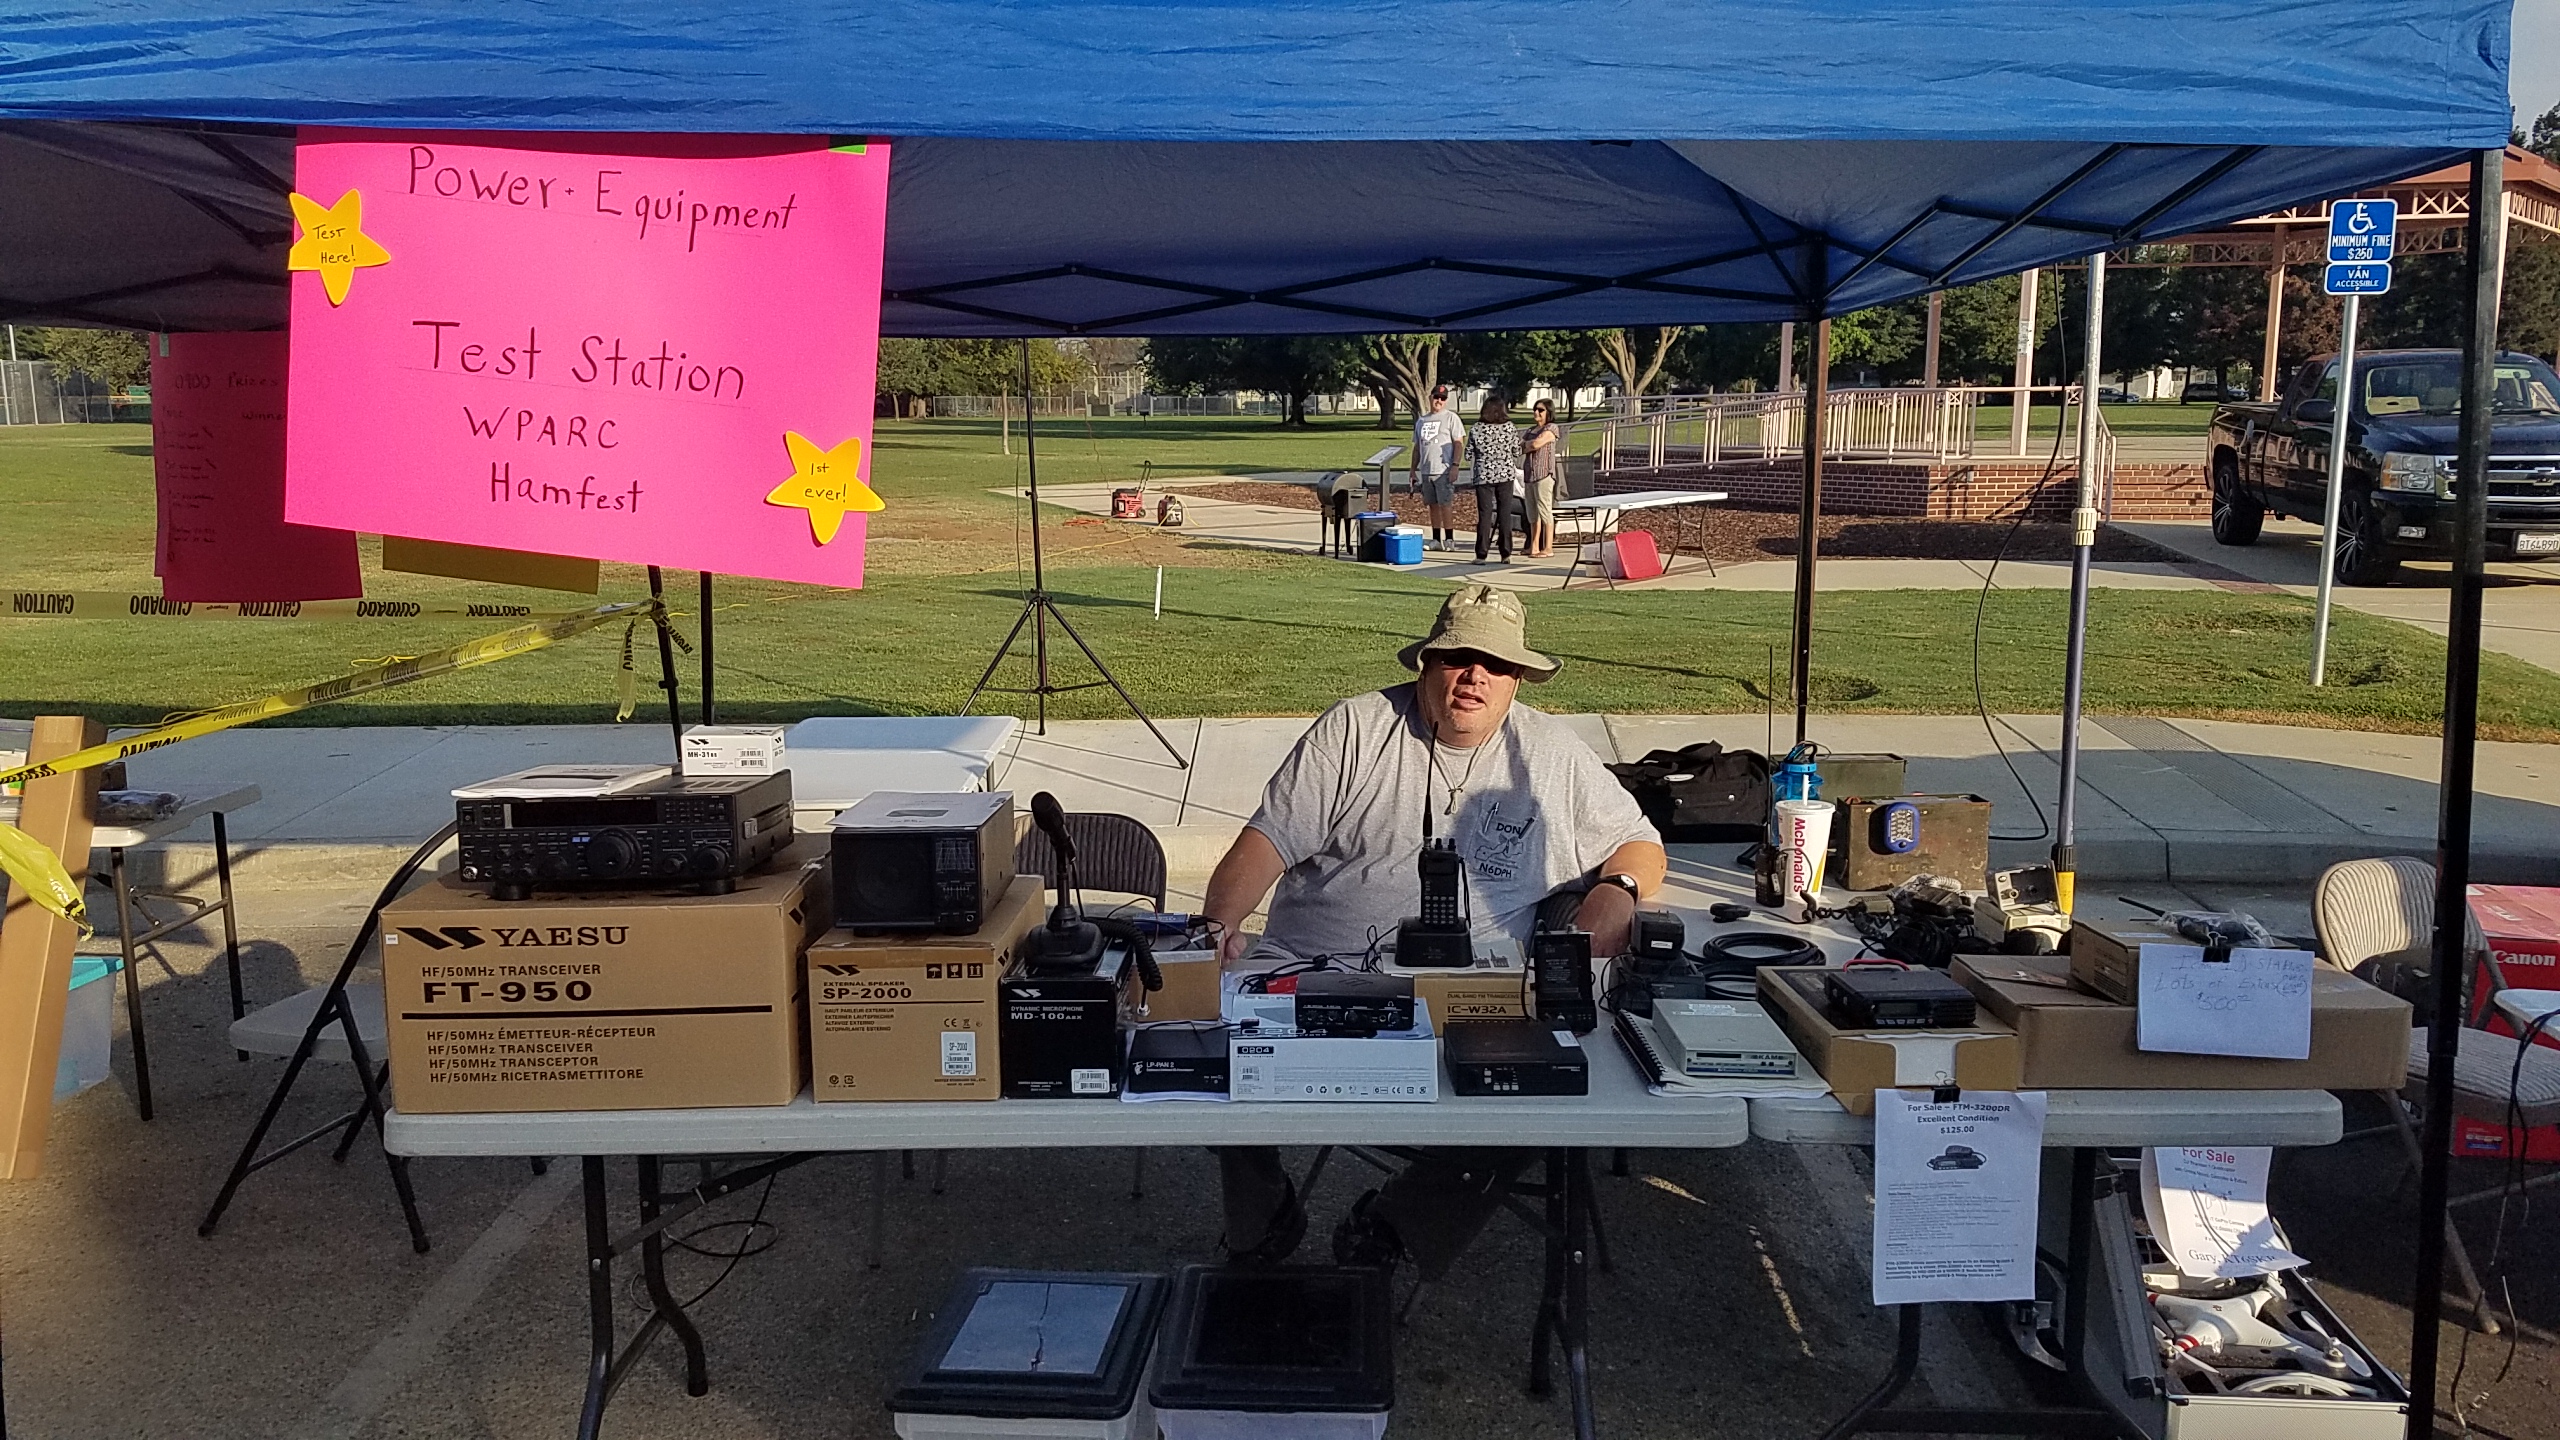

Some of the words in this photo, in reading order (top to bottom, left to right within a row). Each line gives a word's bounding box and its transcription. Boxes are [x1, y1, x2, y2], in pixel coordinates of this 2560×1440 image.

[409, 145, 555, 209] Power
[597, 169, 798, 252] Equipment
[312, 224, 346, 241] Test
[2332, 235, 2368, 247] MINIMUM
[2372, 235, 2391, 247] FINE
[320, 246, 356, 265] Here!
[2347, 247, 2373, 260] $250
[2348, 270, 2370, 279] VAN
[412, 320, 542, 380] Test
[571, 335, 744, 400] Station
[463, 405, 619, 448] WPARC
[810, 461, 830, 476] 1st
[491, 461, 643, 513] Hamfest
[803, 483, 847, 502] ever!
[13, 593, 74, 615] CAUTION
[238, 601, 301, 618] CAUTION
[356, 600, 421, 618] CUIDADO
[1495, 822, 1522, 835] DON
[1794, 817, 1807, 893] McDonald's
[1479, 862, 1512, 879] N6DPH
[492, 926, 629, 947] YAESU
[2494, 950, 2556, 967] Canon
[422, 966, 495, 978] HF/50MHz
[499, 964, 601, 976] TRANSCEIVER
[422, 980, 592, 1004] FT-950
[823, 987, 912, 999] SP-2000
[1447, 1005, 1507, 1014] IC-W32A
[426, 1029, 495, 1041] HF/50MHz
[498, 1025, 656, 1040] ÉMETTEUR-RÉCEPTEUR
[428, 1044, 496, 1055] HF/50MHz
[499, 1042, 593, 1054] TRANSCEIVER
[1241, 1046, 1270, 1054] 0204
[429, 1058, 497, 1069] HF/50MHz
[500, 1056, 599, 1067] TRANSCEPTOR
[430, 1072, 497, 1083] HF/50MHz
[501, 1068, 644, 1081] RICETRASMETTITORE
[1907, 1104, 1922, 1112] For
[1924, 1103, 1942, 1112] Sale
[1917, 1115, 1956, 1123] Excellent
[1957, 1115, 2000, 1123] Condition
[1940, 1125, 1975, 1135] $125.00
[2206, 1149, 2236, 1164] Sale
